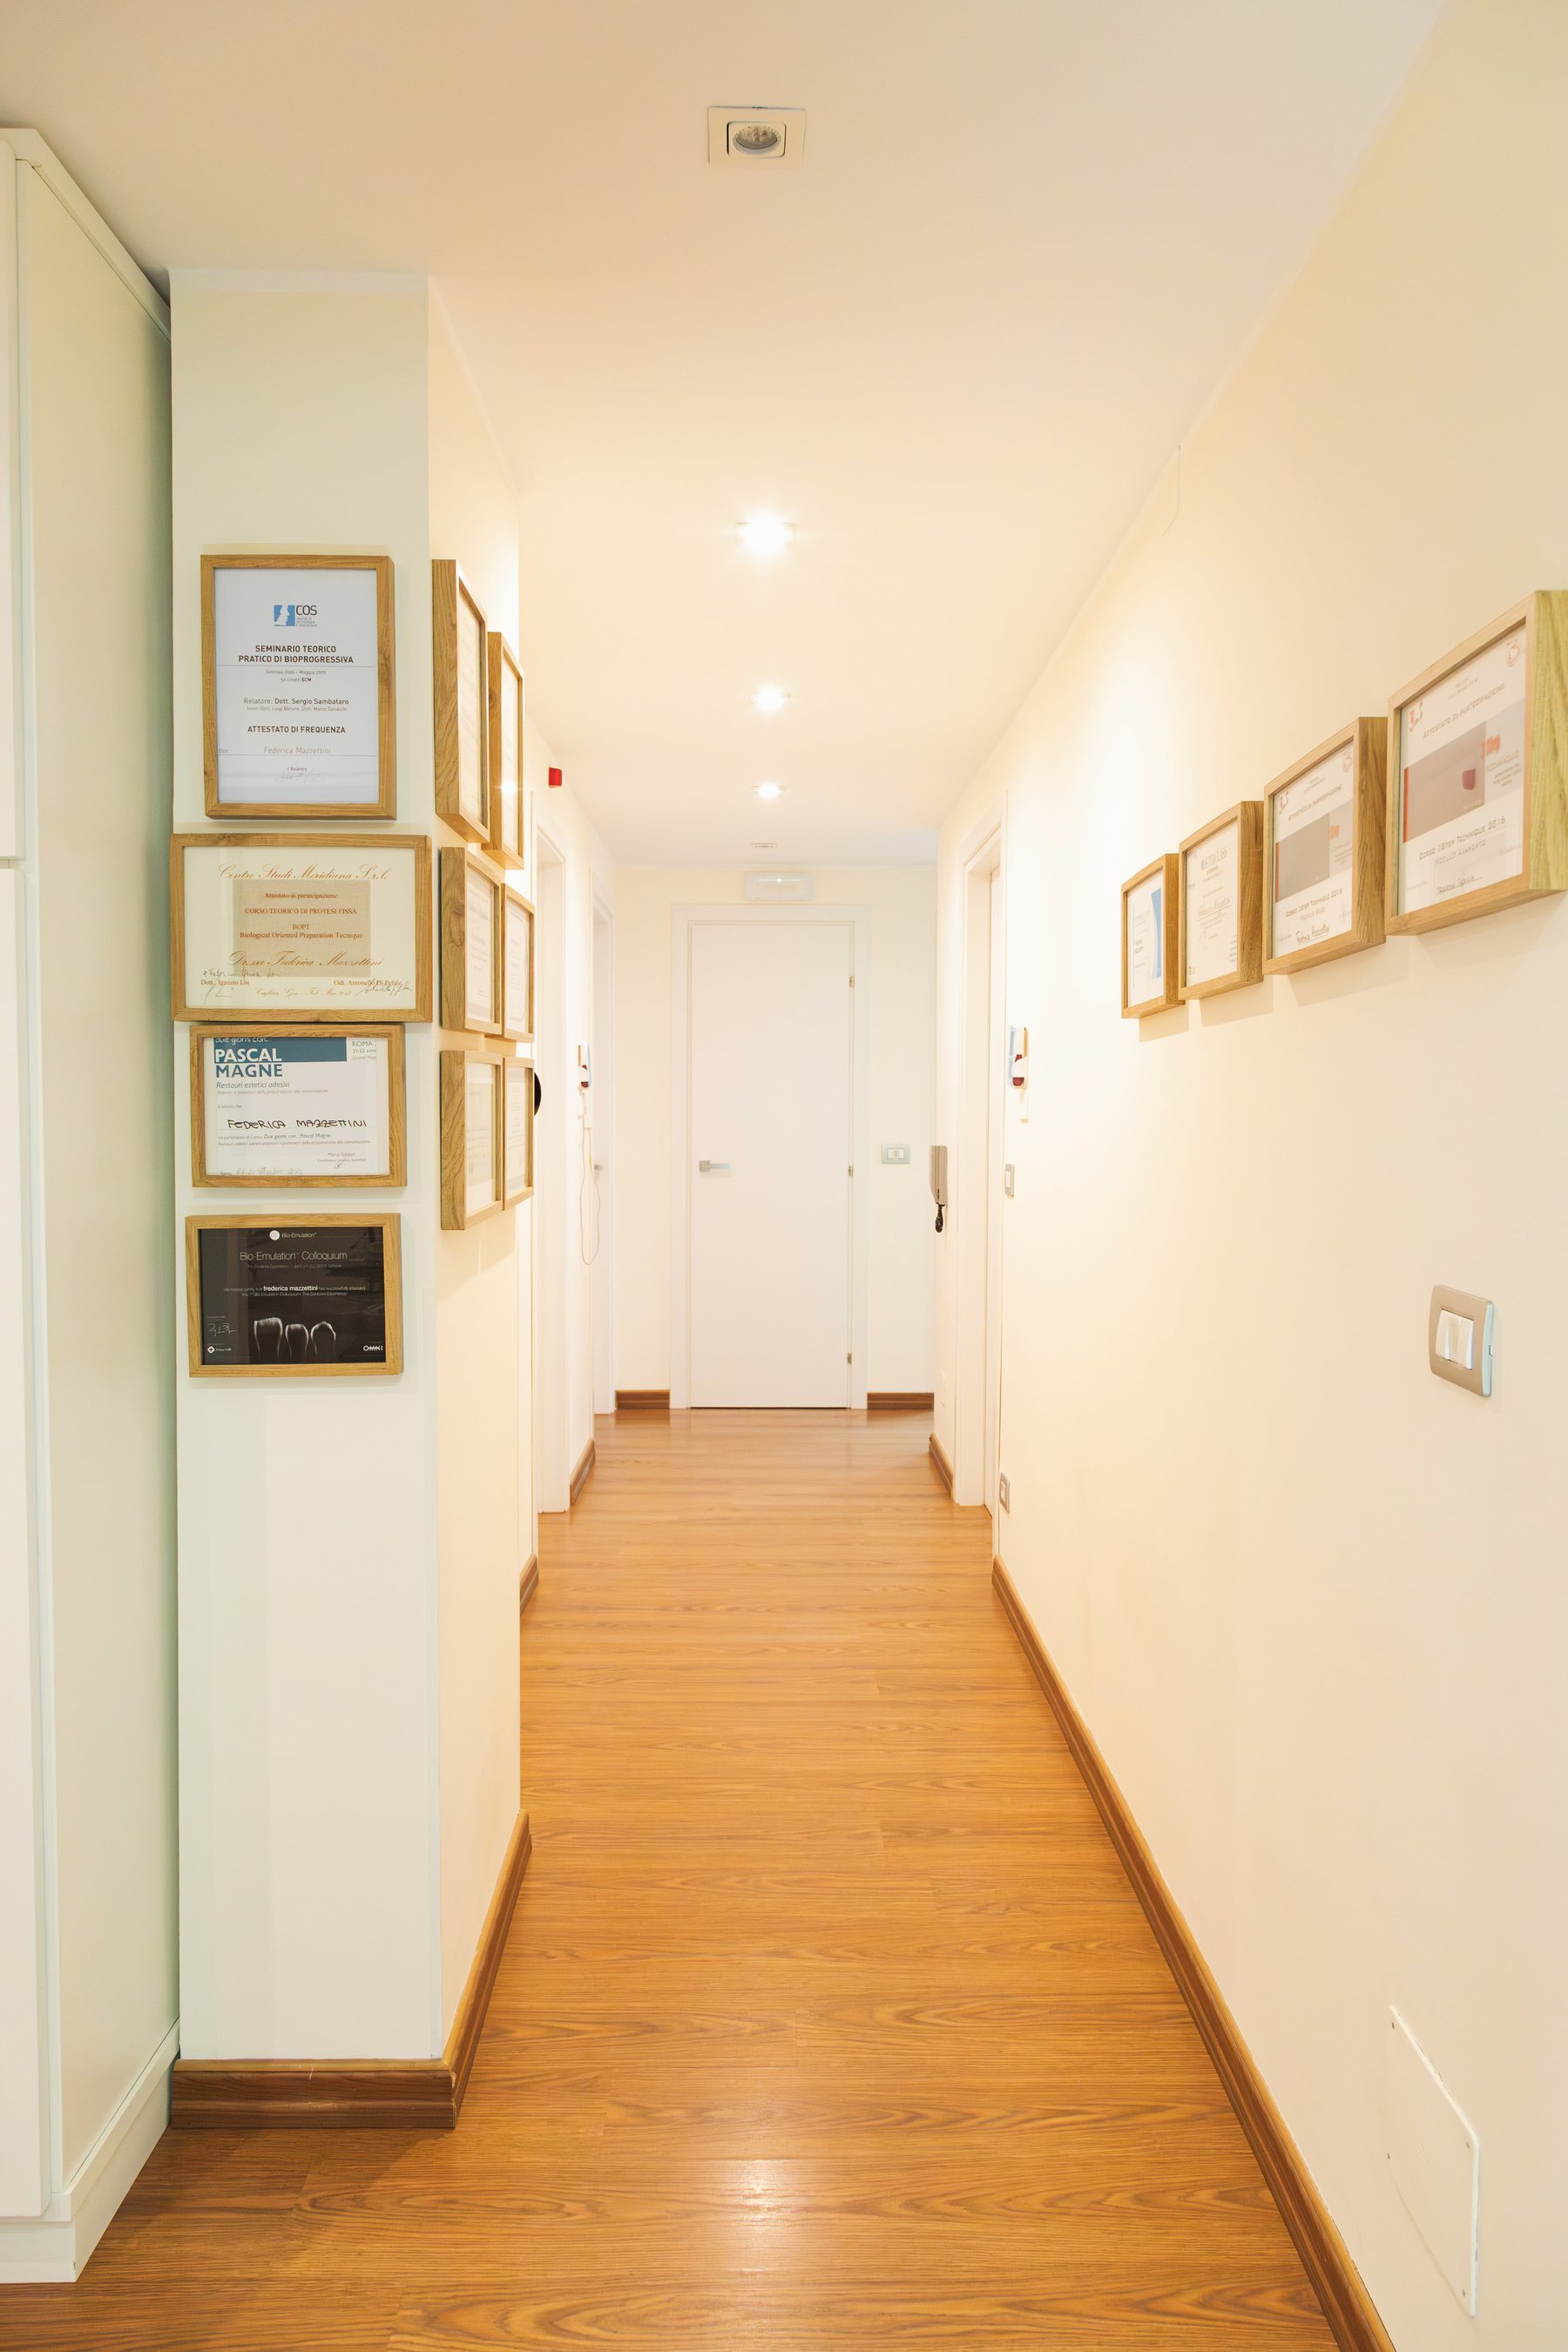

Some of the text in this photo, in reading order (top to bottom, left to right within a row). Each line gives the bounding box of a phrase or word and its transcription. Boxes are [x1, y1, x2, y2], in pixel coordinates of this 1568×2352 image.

[296, 605, 318, 616] COS
[215, 1048, 283, 1063] PASCAL
[216, 1064, 283, 1078] MAGNE
[227, 1119, 367, 1130] FEDERICA MAZZETTINI
[301, 1250, 348, 1261] Colloquium
